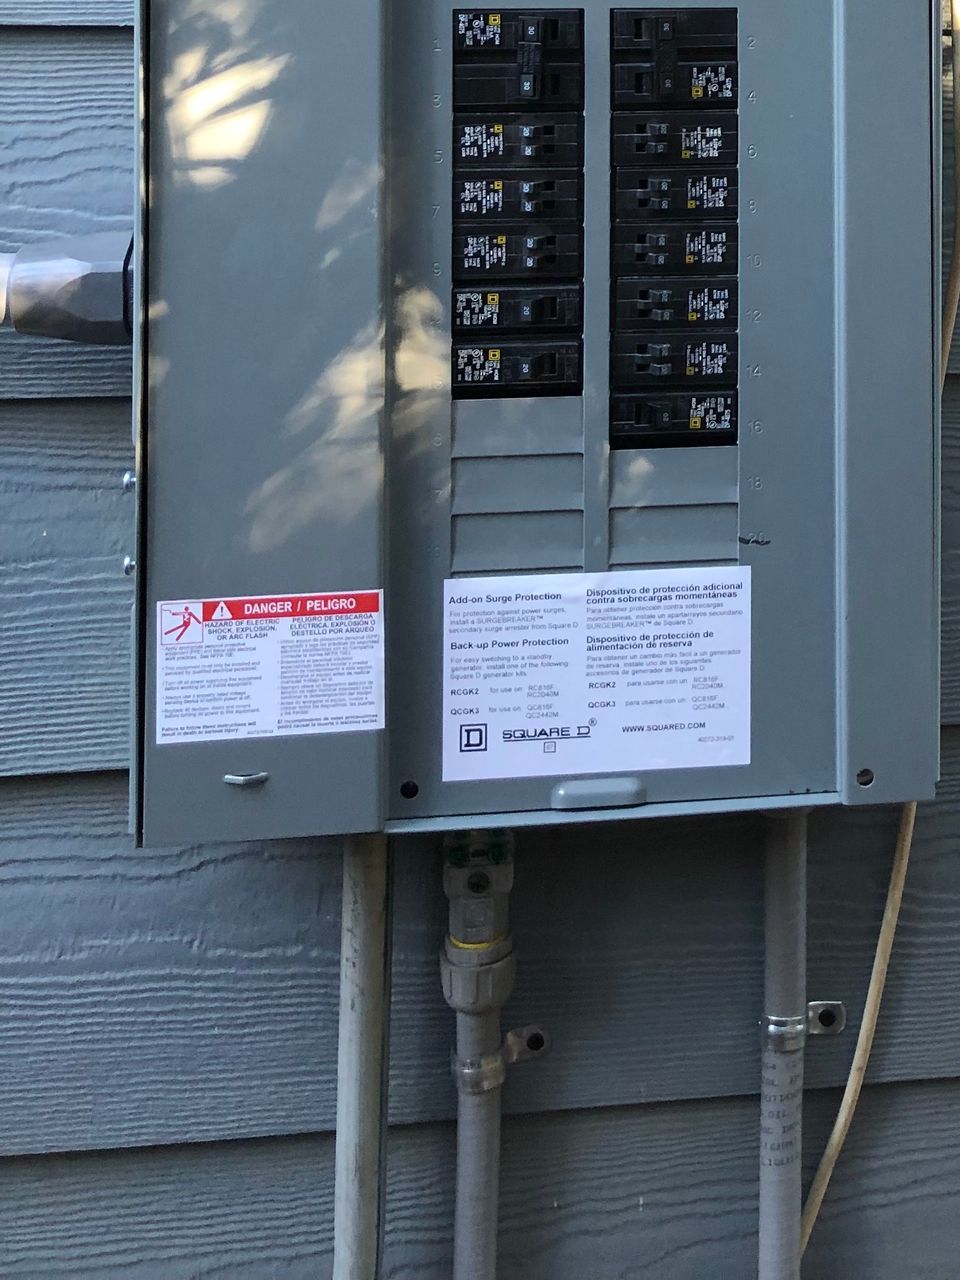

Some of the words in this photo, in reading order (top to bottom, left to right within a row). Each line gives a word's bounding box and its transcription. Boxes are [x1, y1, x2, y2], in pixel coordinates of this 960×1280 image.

[527, 25, 535, 35] 30
[524, 81, 531, 91] 30
[523, 127, 530, 137] 20
[525, 146, 532, 156] 20
[522, 183, 530, 192] 20
[525, 202, 532, 212] 20
[526, 238, 534, 248] 20
[526, 257, 534, 267] 20
[523, 306, 530, 316] 20
[523, 364, 529, 373] 20
[586, 587, 636, 597] Dispositivo
[653, 584, 700, 594] protección
[703, 582, 743, 590] adicional
[449, 595, 482, 604] Add-on
[485, 593, 512, 604] Surge
[515, 591, 562, 601] Protection
[618, 593, 672, 604] sobrecargas
[675, 590, 737, 600] momentáneas
[244, 601, 292, 614] DANGER
[297, 601, 301, 611] /
[306, 598, 356, 611] PELIGRO
[586, 634, 637, 644] Dispositivo
[653, 631, 700, 641] protección
[450, 640, 488, 651] Back-up
[491, 639, 519, 647] Power
[522, 637, 569, 646] Protection
[586, 642, 643, 651] alimentación
[450, 688, 479, 696] RCGK2
[588, 700, 616, 708] QCGK3
[450, 707, 479, 715] QCGK3
[622, 722, 706, 732] WWW.SQUARED.COM
[502, 726, 571, 739] SQUARE
